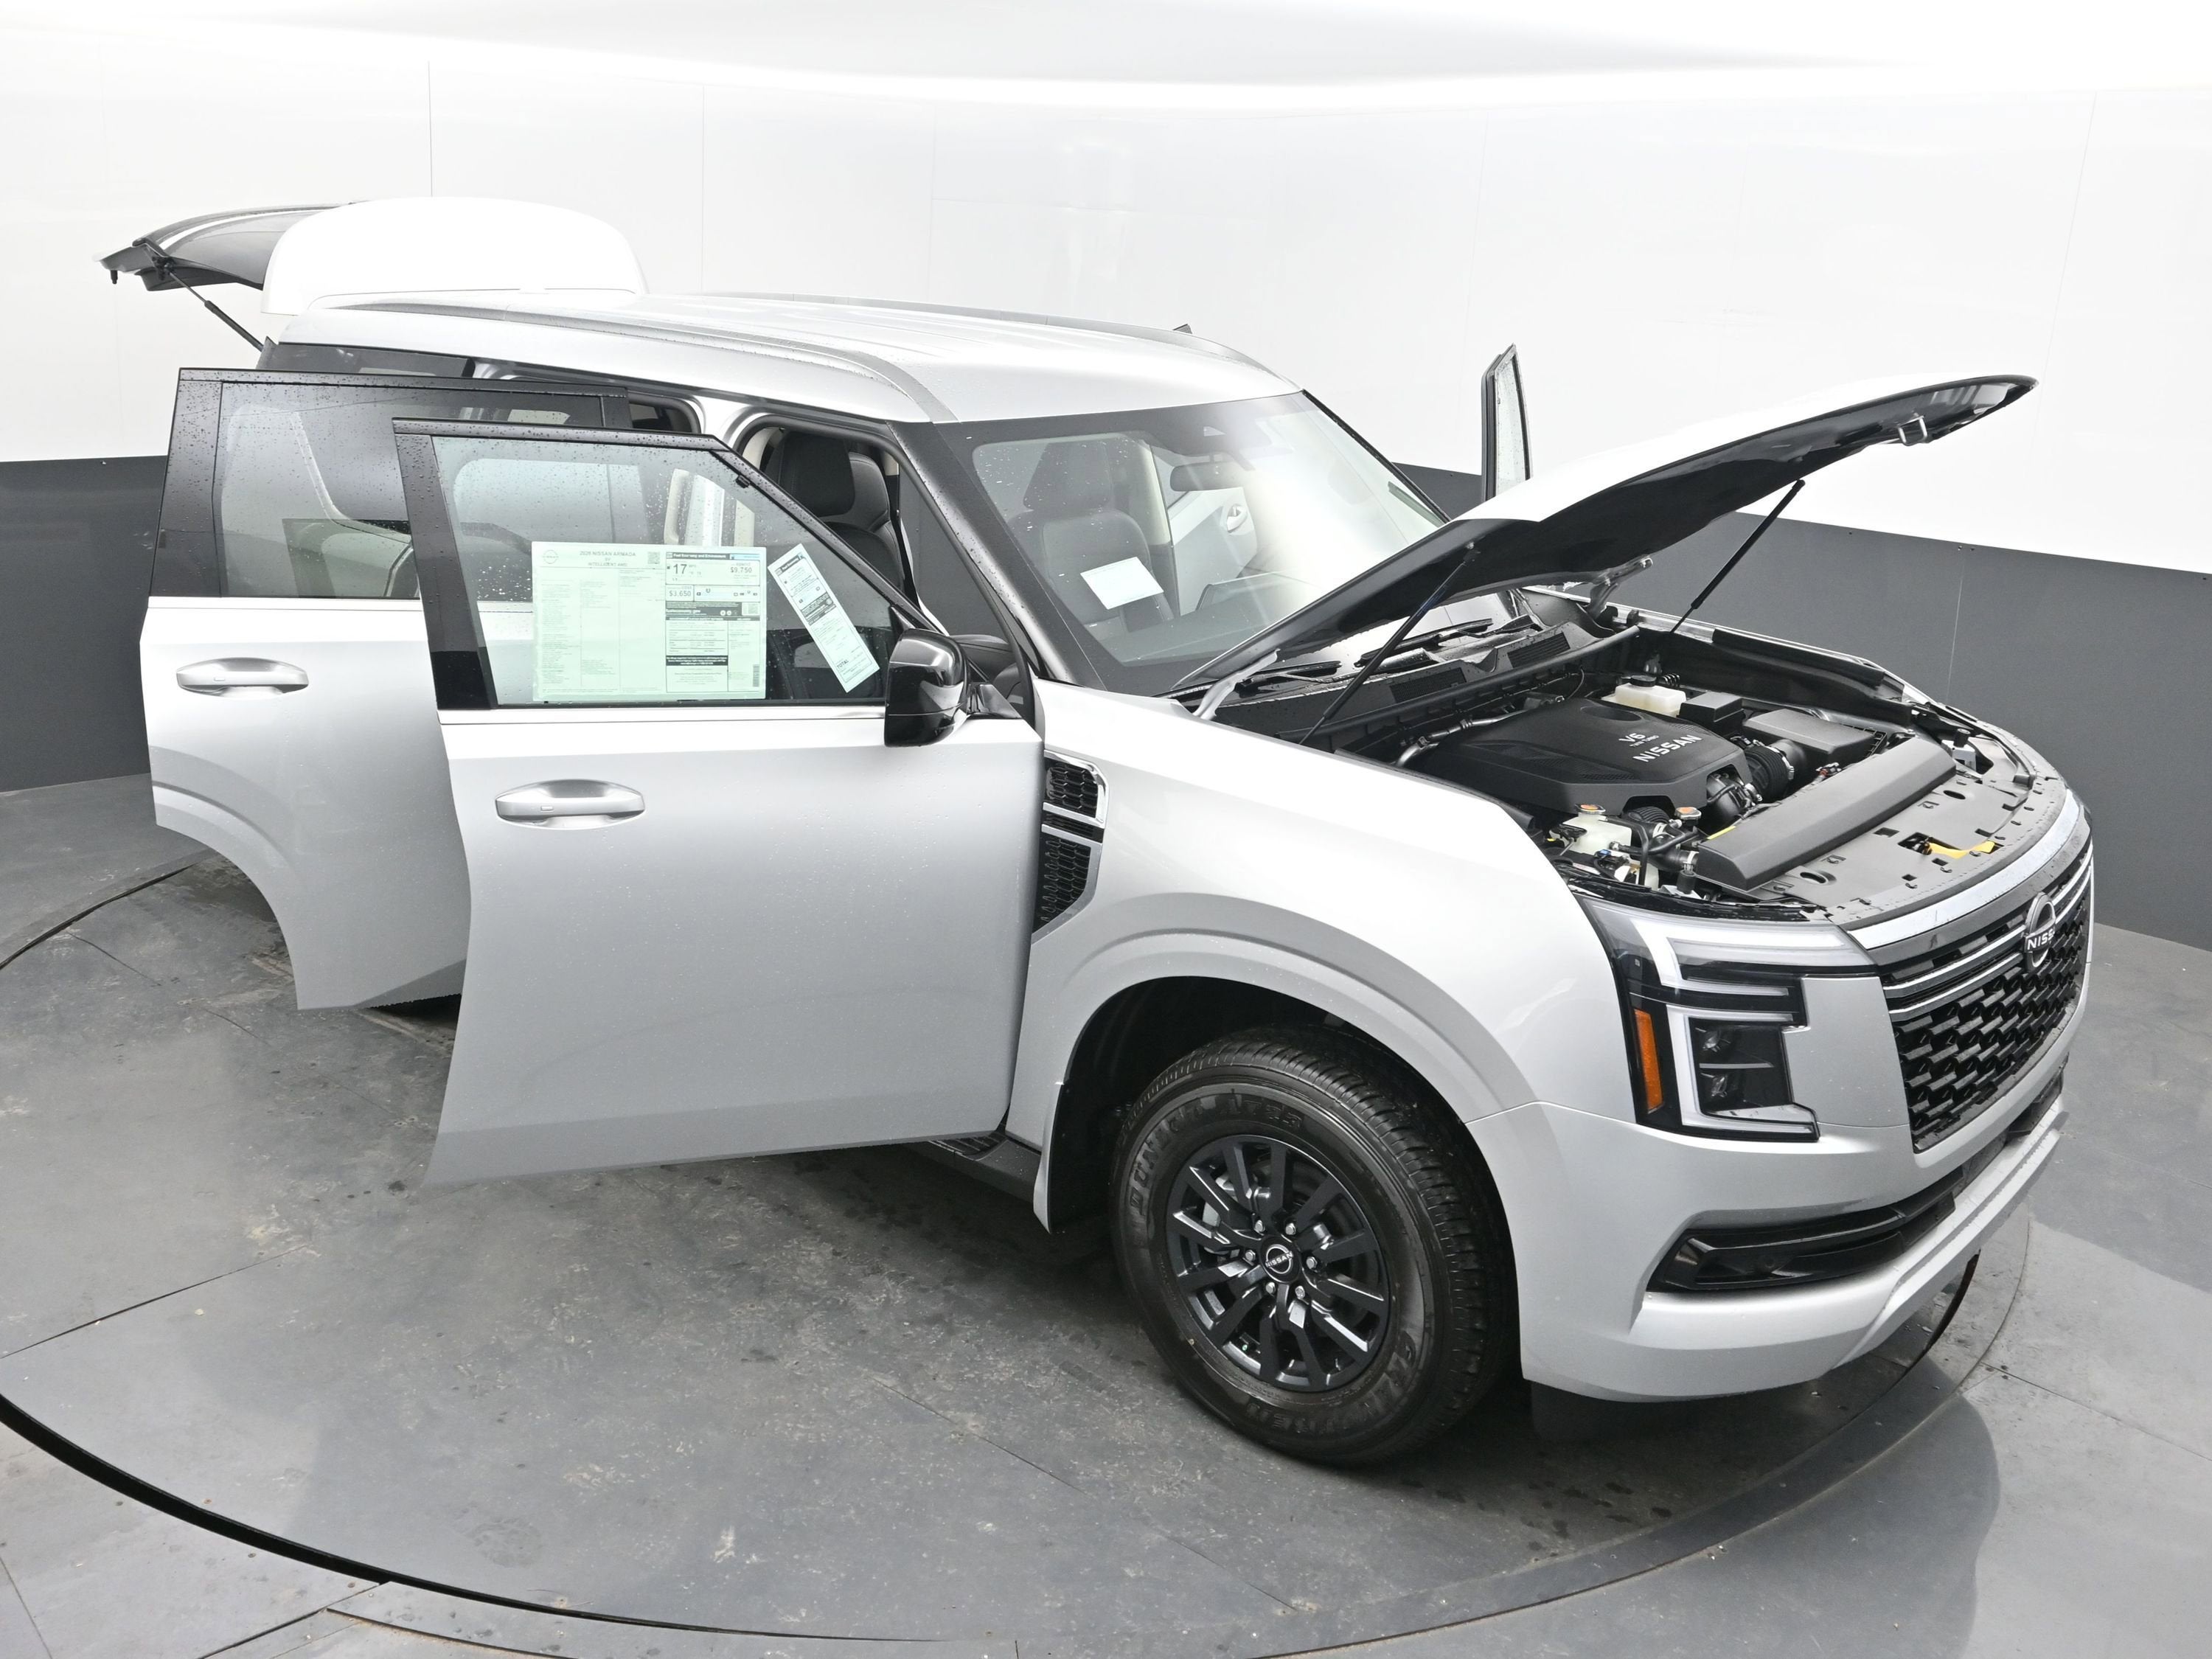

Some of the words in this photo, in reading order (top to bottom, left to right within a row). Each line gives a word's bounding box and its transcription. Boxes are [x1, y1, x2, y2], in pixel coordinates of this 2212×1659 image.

[673, 563, 687, 574] 17
[836, 659, 849, 669] TOTAL
[1618, 733, 1646, 742] V6
[1632, 734, 1703, 762] NISSAN
[2027, 928, 2056, 950] NISS
[1265, 1251, 1294, 1268] NISSAN
